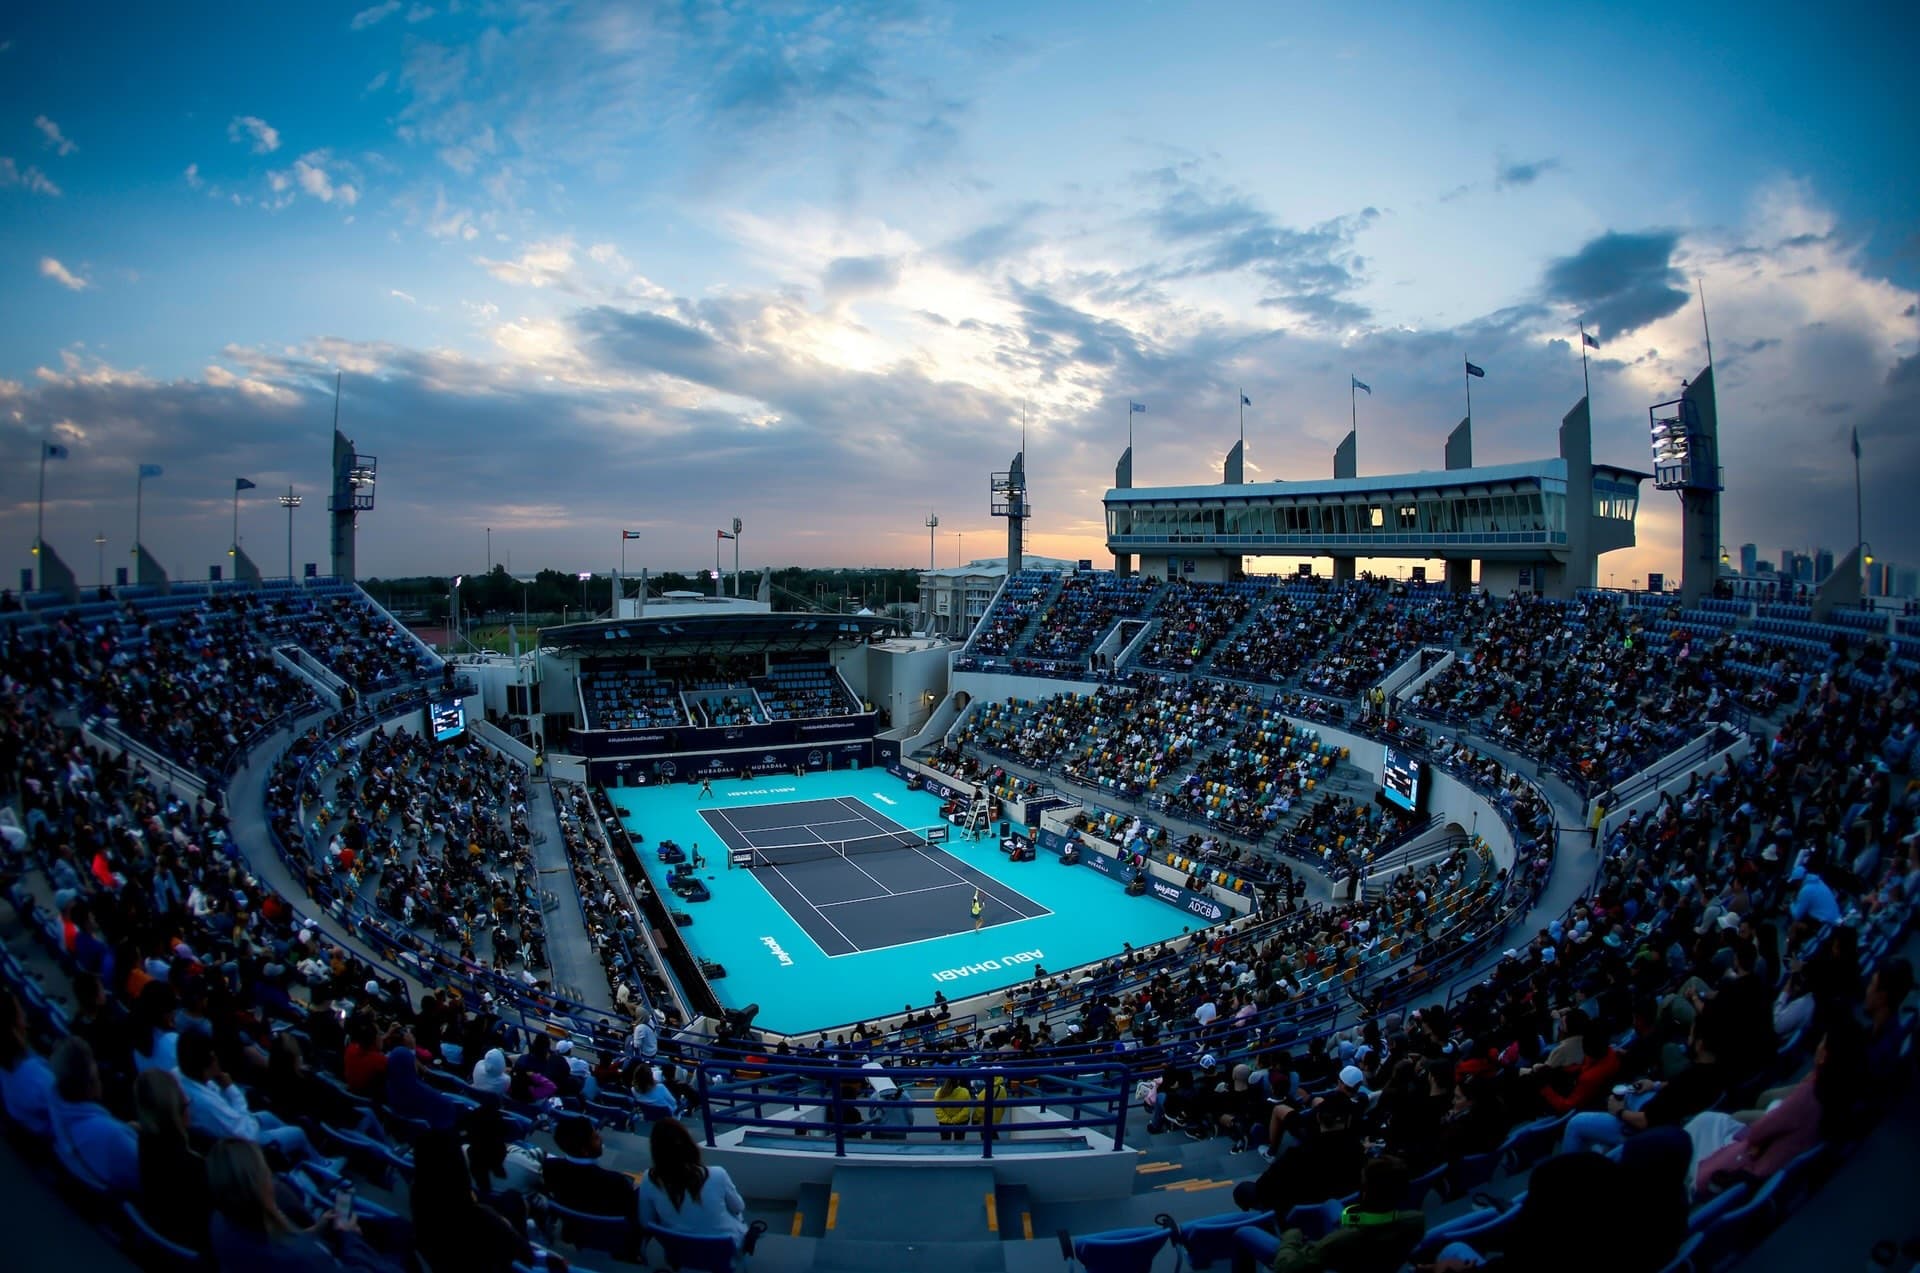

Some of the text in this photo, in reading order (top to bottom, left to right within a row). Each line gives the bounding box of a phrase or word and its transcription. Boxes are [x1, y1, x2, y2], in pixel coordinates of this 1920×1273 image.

[697, 766, 735, 775] MUBADALA
[751, 762, 788, 770] MUBADALA
[1187, 901, 1212, 918] ADCB
[931, 948, 1045, 982] ABU DHABI
